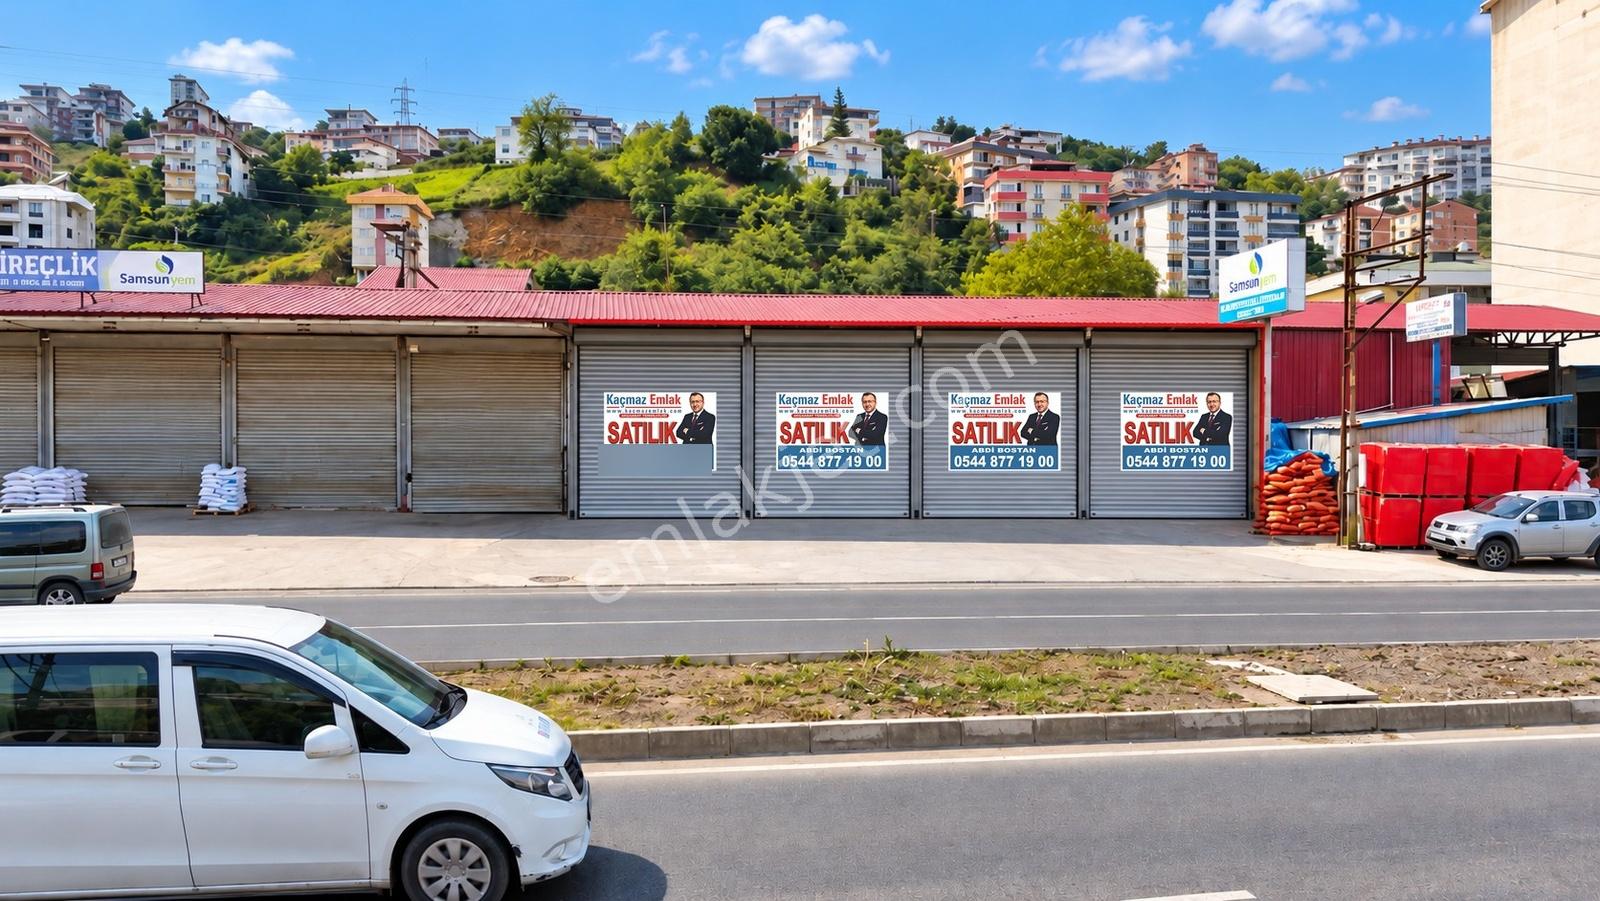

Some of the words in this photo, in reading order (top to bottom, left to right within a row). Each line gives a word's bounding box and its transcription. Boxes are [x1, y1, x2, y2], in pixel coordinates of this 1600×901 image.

[119, 273, 196, 287] Samsunyem
[606, 394, 647, 407] Kaçmaz
[650, 394, 681, 405] Emlak
[778, 394, 819, 407] Kaçmaz
[822, 394, 853, 405] Emlak
[951, 394, 991, 407] Kaçmaz
[994, 394, 1026, 405] Emlak
[1123, 394, 1163, 407] Kaçmaz
[1166, 394, 1198, 405] Emlak
[607, 421, 678, 444] SATILIK
[780, 421, 850, 444] SATILIK
[952, 421, 1022, 444] SATILIK
[1124, 421, 1194, 444] SATILIK
[782, 455, 814, 468] 0544
[818, 455, 841, 468] 877
[846, 455, 861, 468] 19
[866, 455, 881, 468] 00
[954, 455, 986, 468] 0544
[990, 455, 1014, 468] 877
[1018, 455, 1034, 468] 19
[1037, 455, 1054, 468] 00
[1126, 455, 1158, 468] 0544
[1162, 455, 1186, 468] 877
[1190, 455, 1206, 468] 19
[1210, 455, 1226, 468] 00
